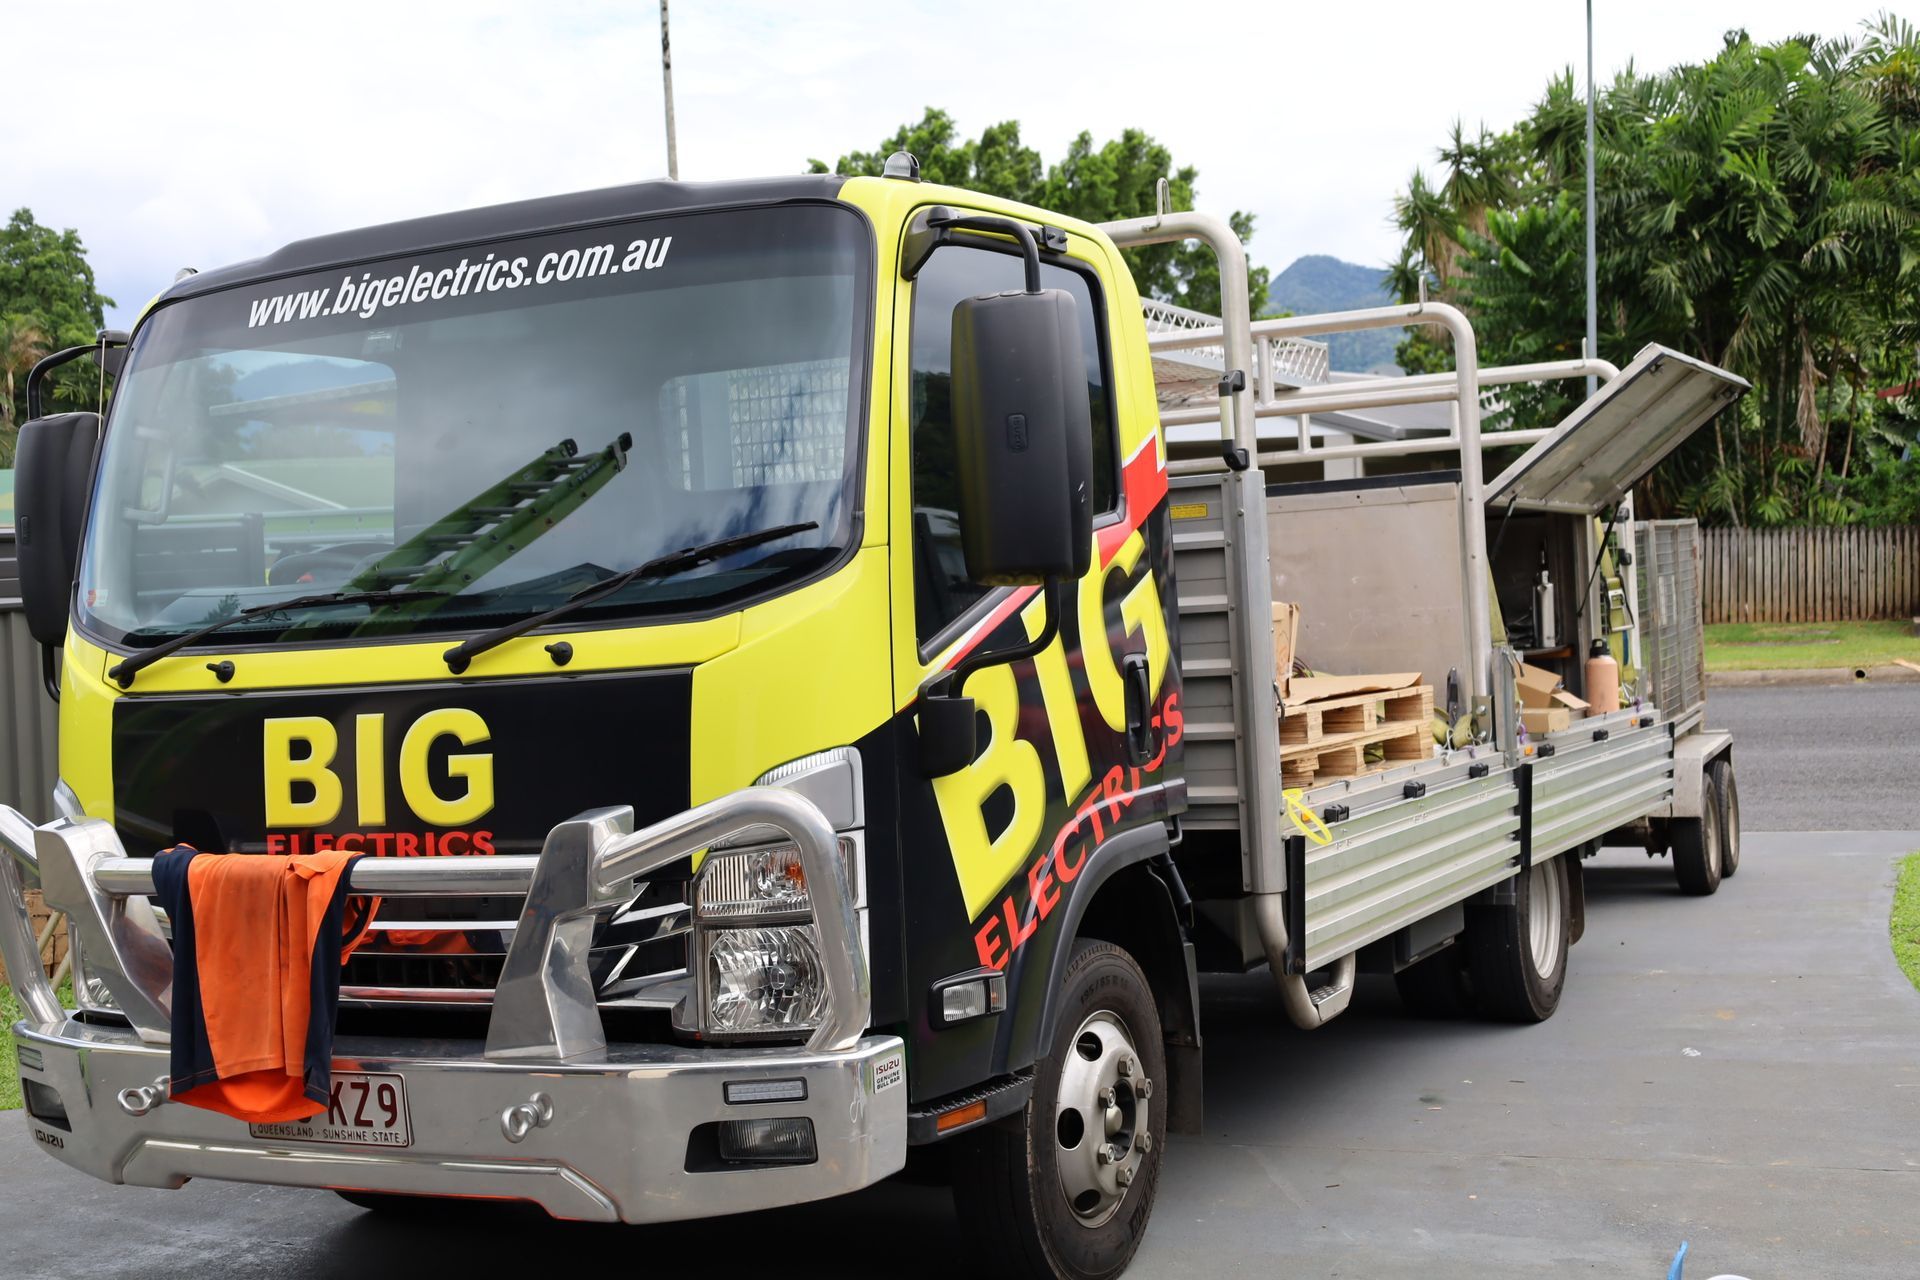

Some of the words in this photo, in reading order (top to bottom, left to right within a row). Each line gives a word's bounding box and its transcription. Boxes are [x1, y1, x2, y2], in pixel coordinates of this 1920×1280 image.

[248, 236, 672, 328] www.bigelectrics.com.au
[914, 529, 1170, 924] BIG
[264, 708, 494, 828] BIG
[266, 831, 495, 857] ELECTRICS
[876, 1058, 899, 1075] ISUZU
[876, 1070, 899, 1084] GENUINE
[876, 1080, 889, 1090] BULL
[890, 1075, 900, 1084] BAR
[35, 1128, 64, 1149] ISUZU
[257, 1124, 314, 1138] QUEENSLAND
[323, 1128, 367, 1142] SUNSHINE
[372, 1131, 400, 1143] STATE
